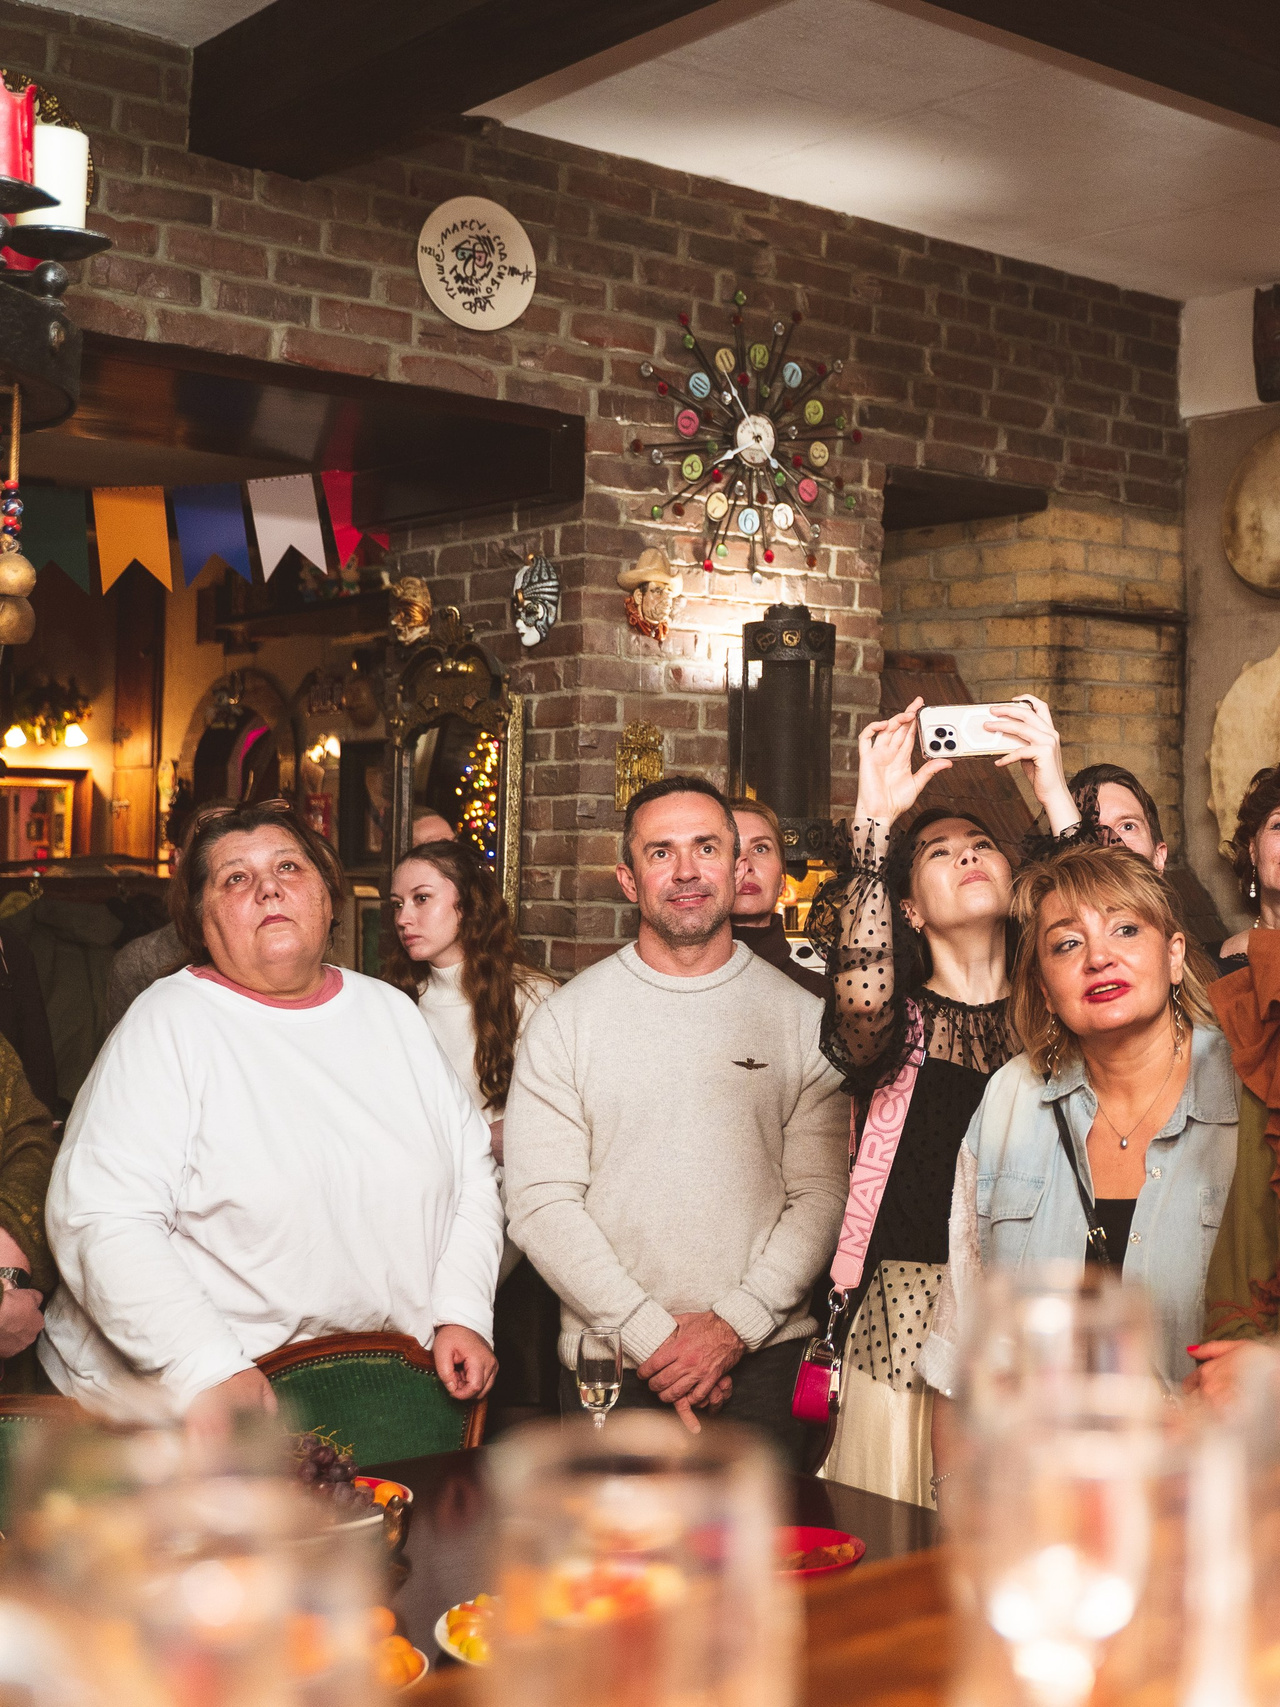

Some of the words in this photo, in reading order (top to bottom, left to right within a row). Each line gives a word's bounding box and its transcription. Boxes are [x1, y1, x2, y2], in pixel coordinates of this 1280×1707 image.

[692, 377, 708, 395] 10
[685, 461, 700, 475] 8
[744, 513, 754, 531] 6
[838, 1088, 908, 1260] MARC
